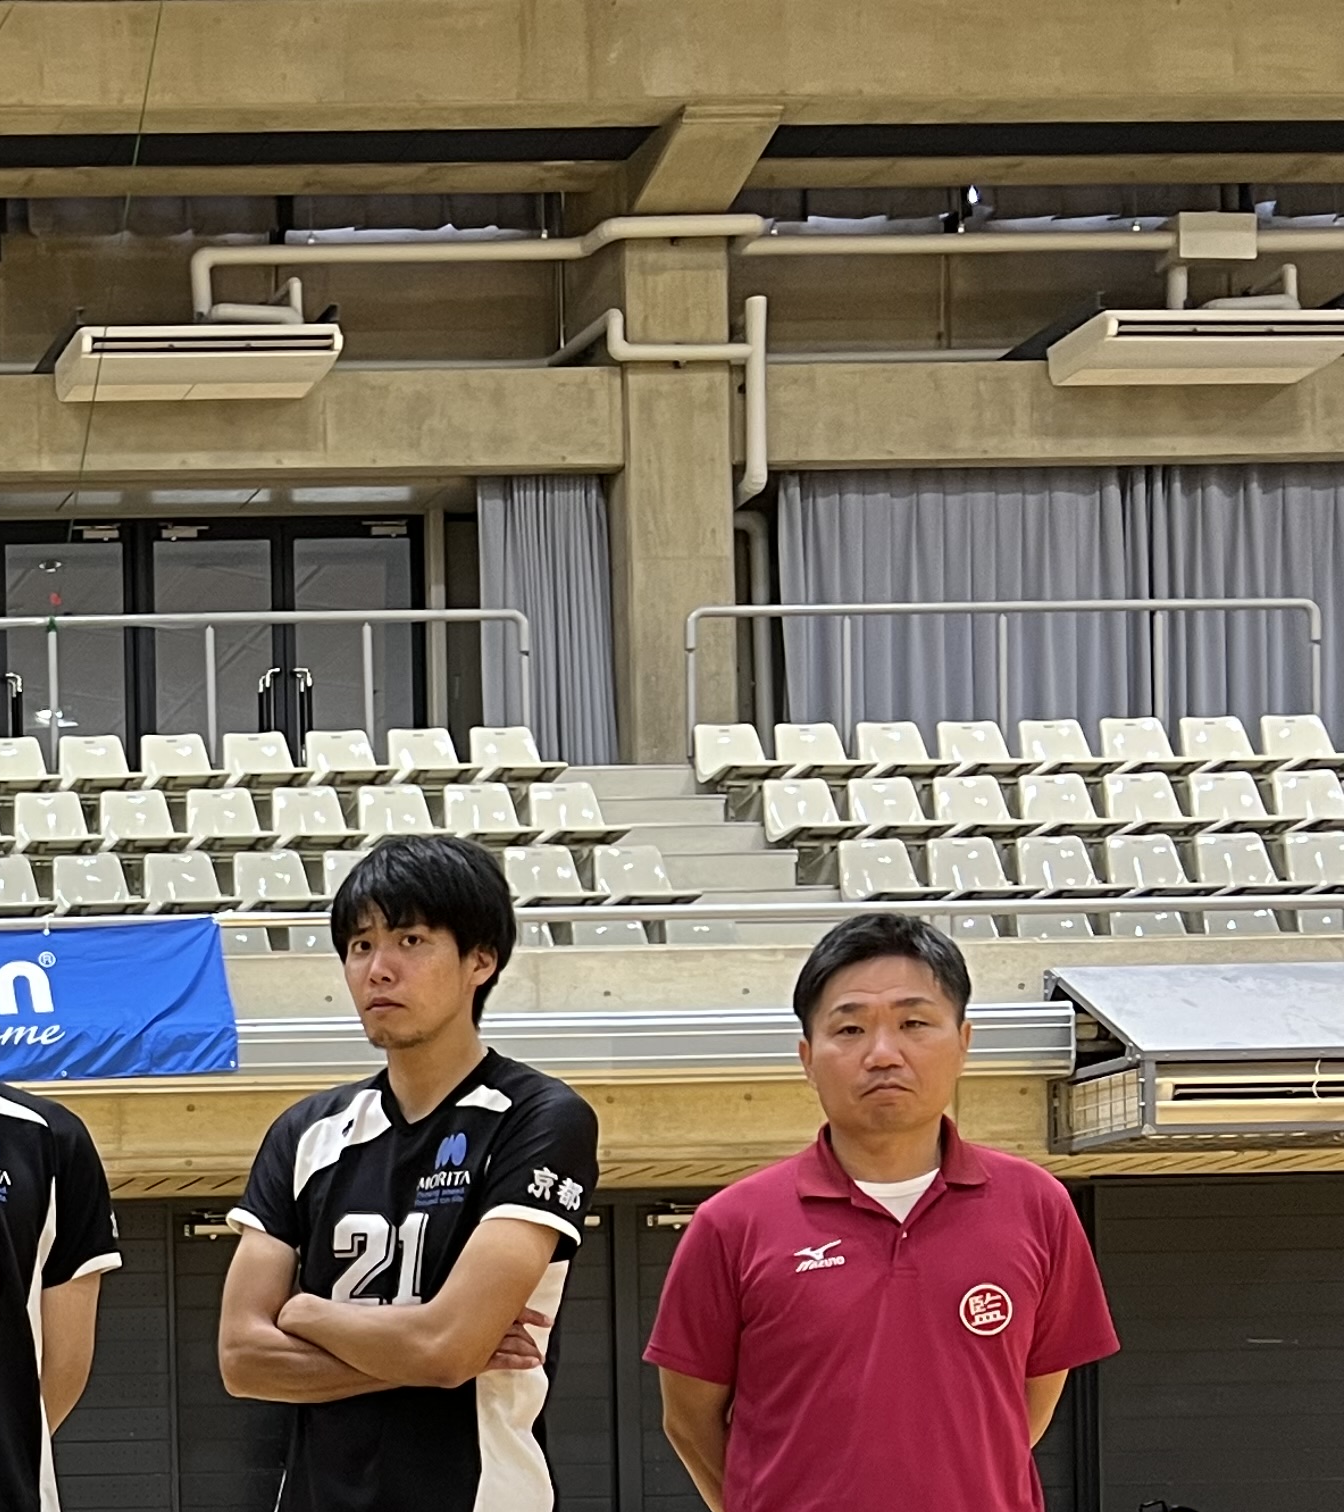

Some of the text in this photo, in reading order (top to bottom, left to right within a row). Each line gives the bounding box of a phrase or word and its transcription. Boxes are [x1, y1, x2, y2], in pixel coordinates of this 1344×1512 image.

[416, 1169, 471, 1191] MORITA
[527, 1167, 584, 1211] 京都
[331, 1212, 430, 1306] 21
[968, 1292, 1007, 1326] 監
